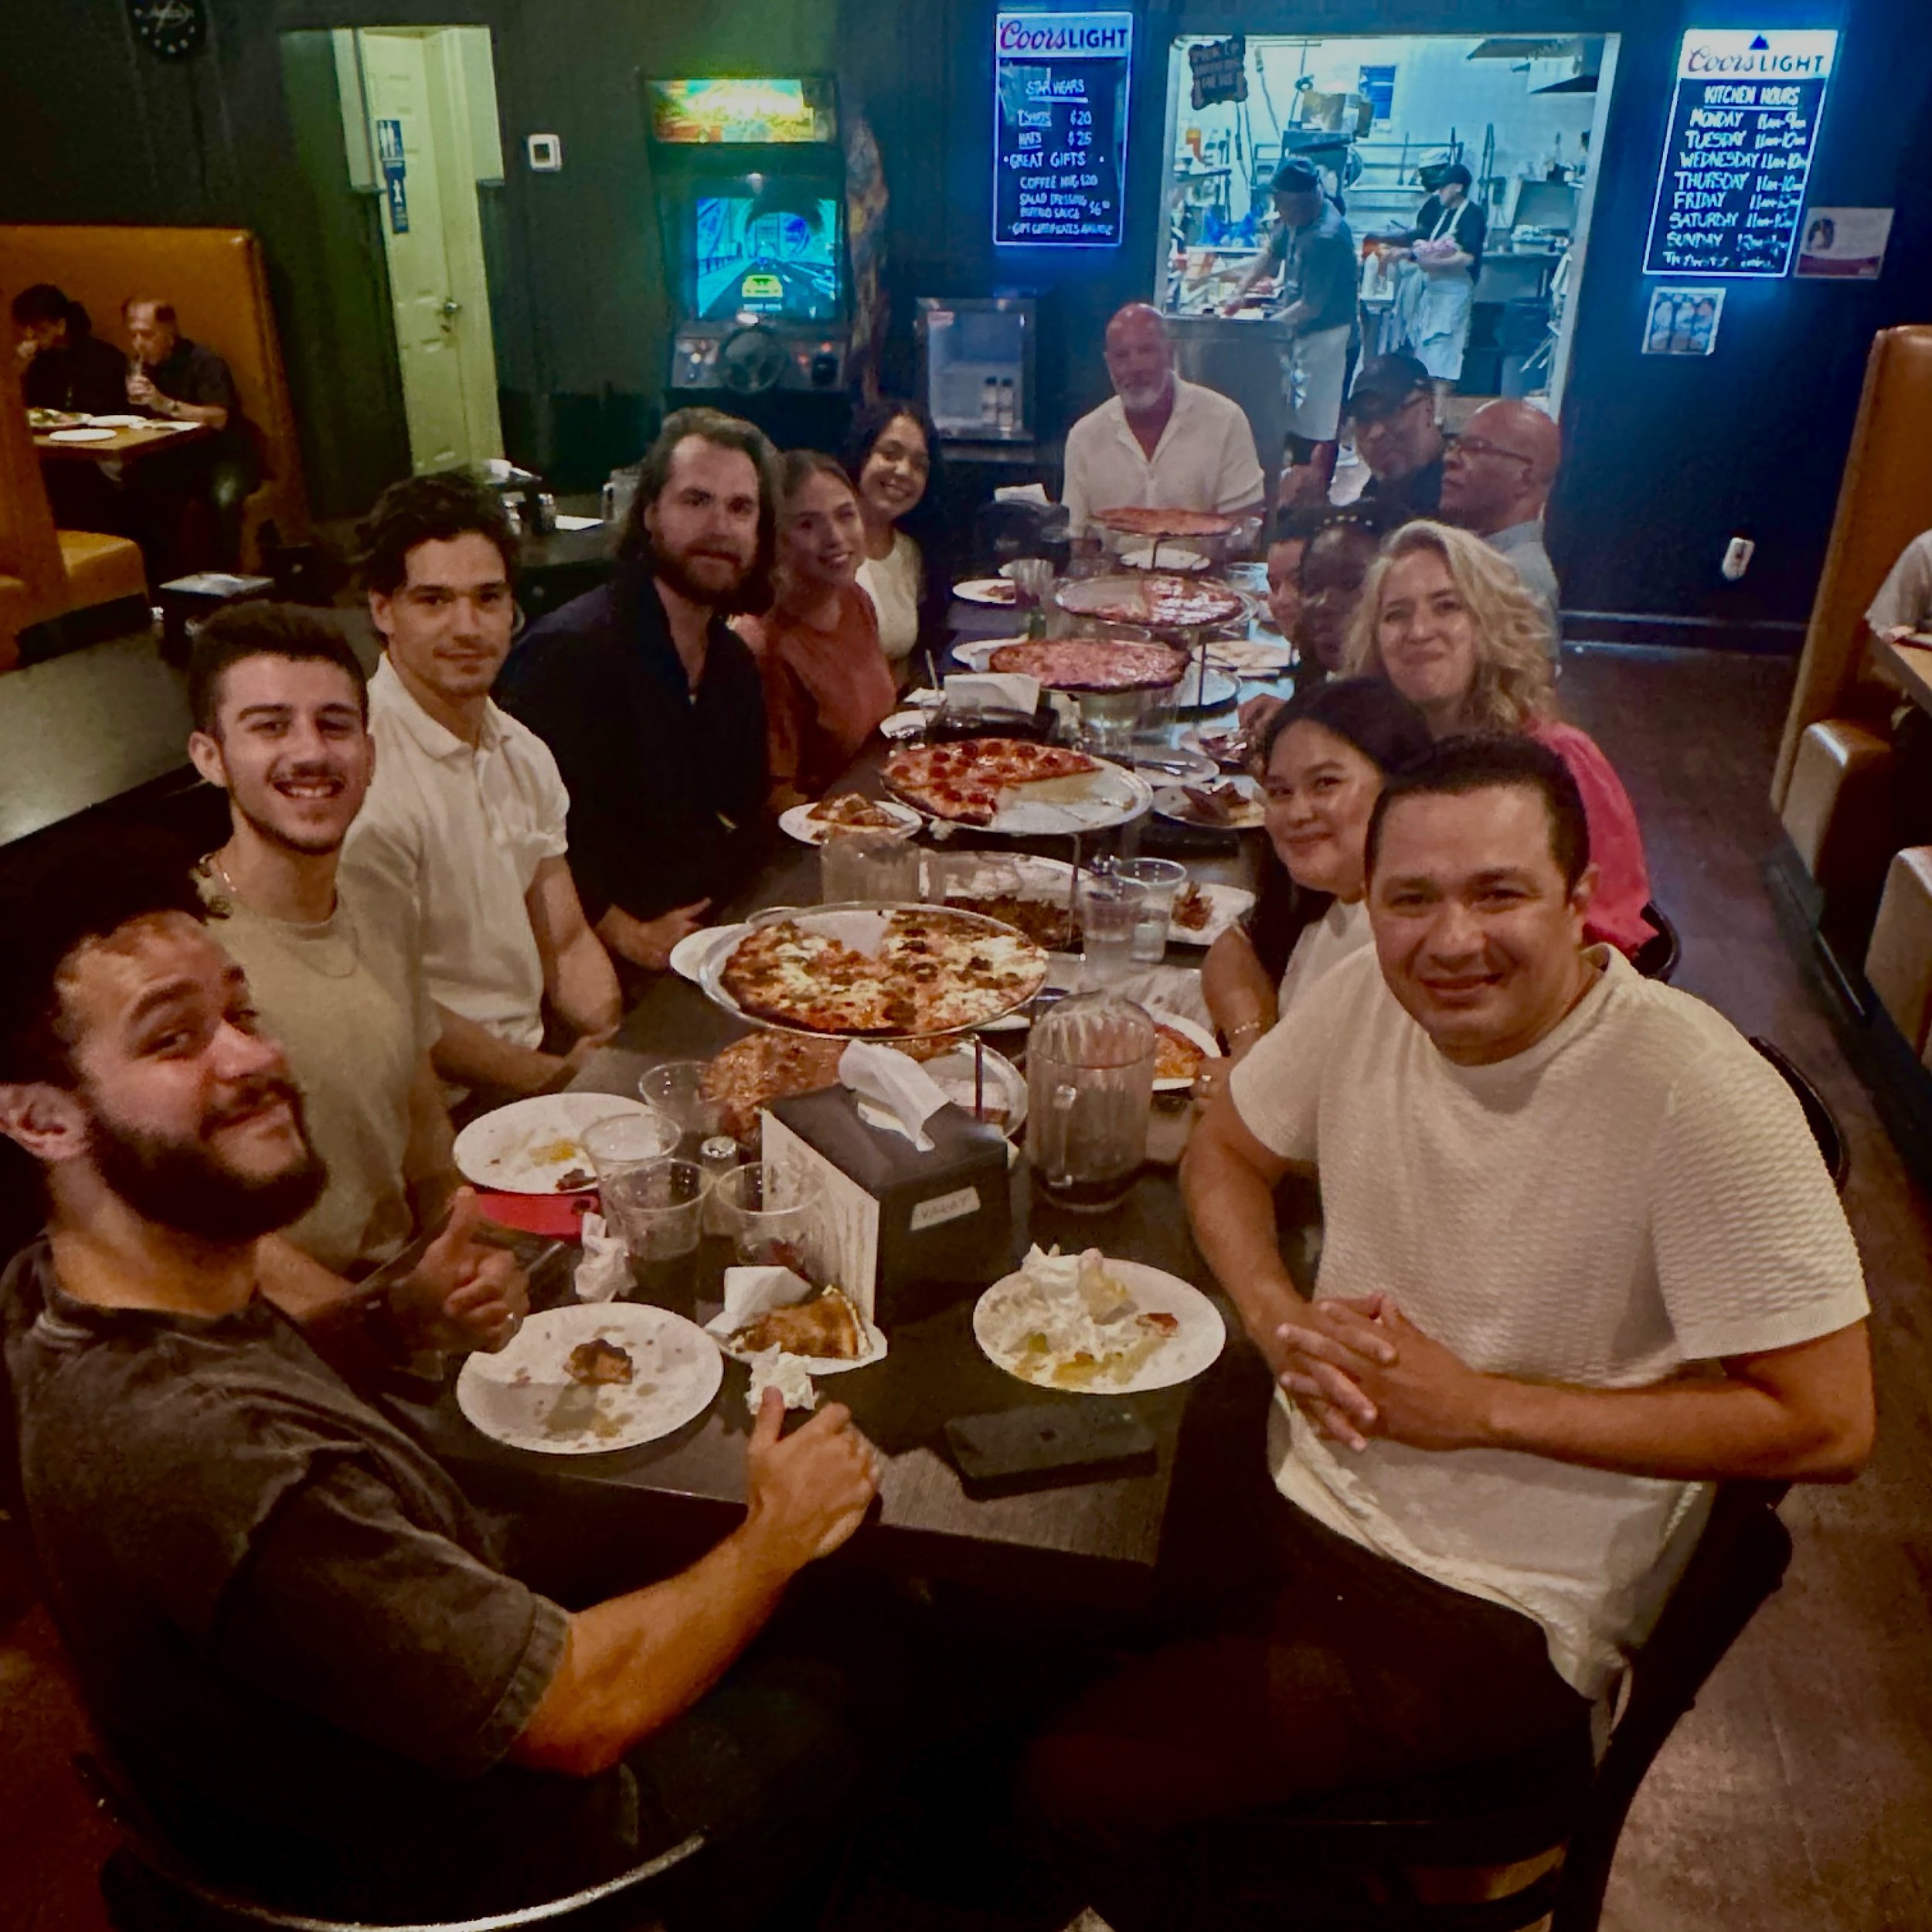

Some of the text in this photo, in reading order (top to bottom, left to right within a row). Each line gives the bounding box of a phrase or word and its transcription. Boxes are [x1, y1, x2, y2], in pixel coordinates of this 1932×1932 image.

[1068, 28, 1128, 49] LIGHT
[1759, 55, 1825, 72] LIGHT
[1704, 85, 1801, 105] KITCHEN HOURS
[1689, 107, 1744, 129] MONDAY
[1685, 130, 1747, 149] TUESDAY
[1009, 151, 1087, 169] GREAT GIFTS
[1679, 151, 1760, 168] WEDNESDAY
[1674, 171, 1750, 191] THURSDAY
[1673, 191, 1728, 209] FRIDAY
[1668, 212, 1739, 230] SATURDAY
[1666, 231, 1724, 248] SUNDAY
